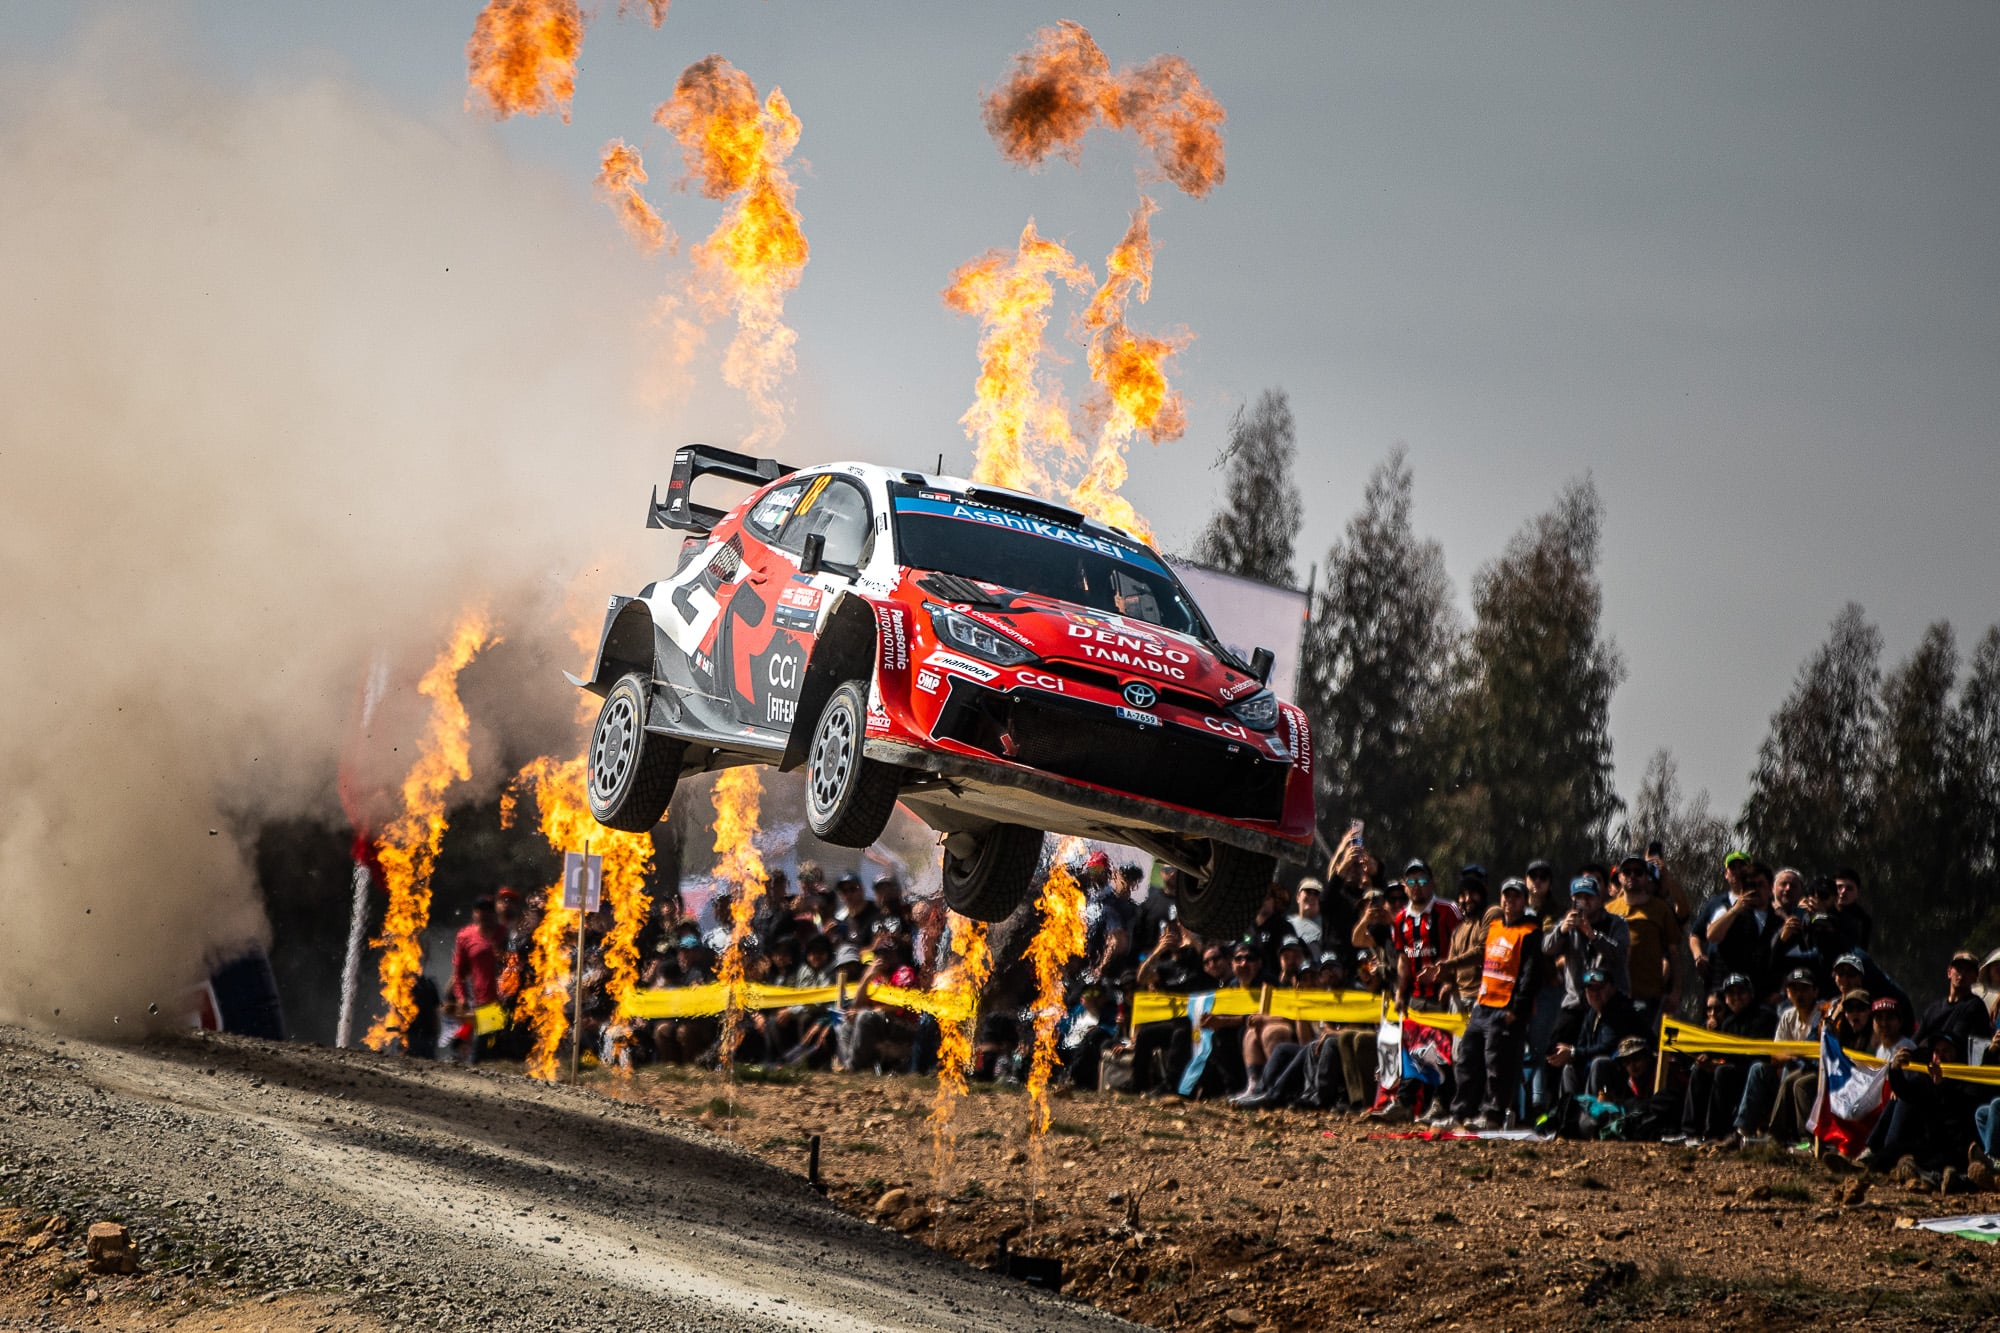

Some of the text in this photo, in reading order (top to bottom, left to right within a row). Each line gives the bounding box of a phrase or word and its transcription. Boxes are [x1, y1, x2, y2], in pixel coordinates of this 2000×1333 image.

[878, 606, 894, 670] AUTOMOTIVE
[890, 608, 909, 670] Panasonic
[1068, 624, 1190, 664] DENSO
[917, 672, 940, 690] OMP
[1126, 710, 1156, 724] A-7659
